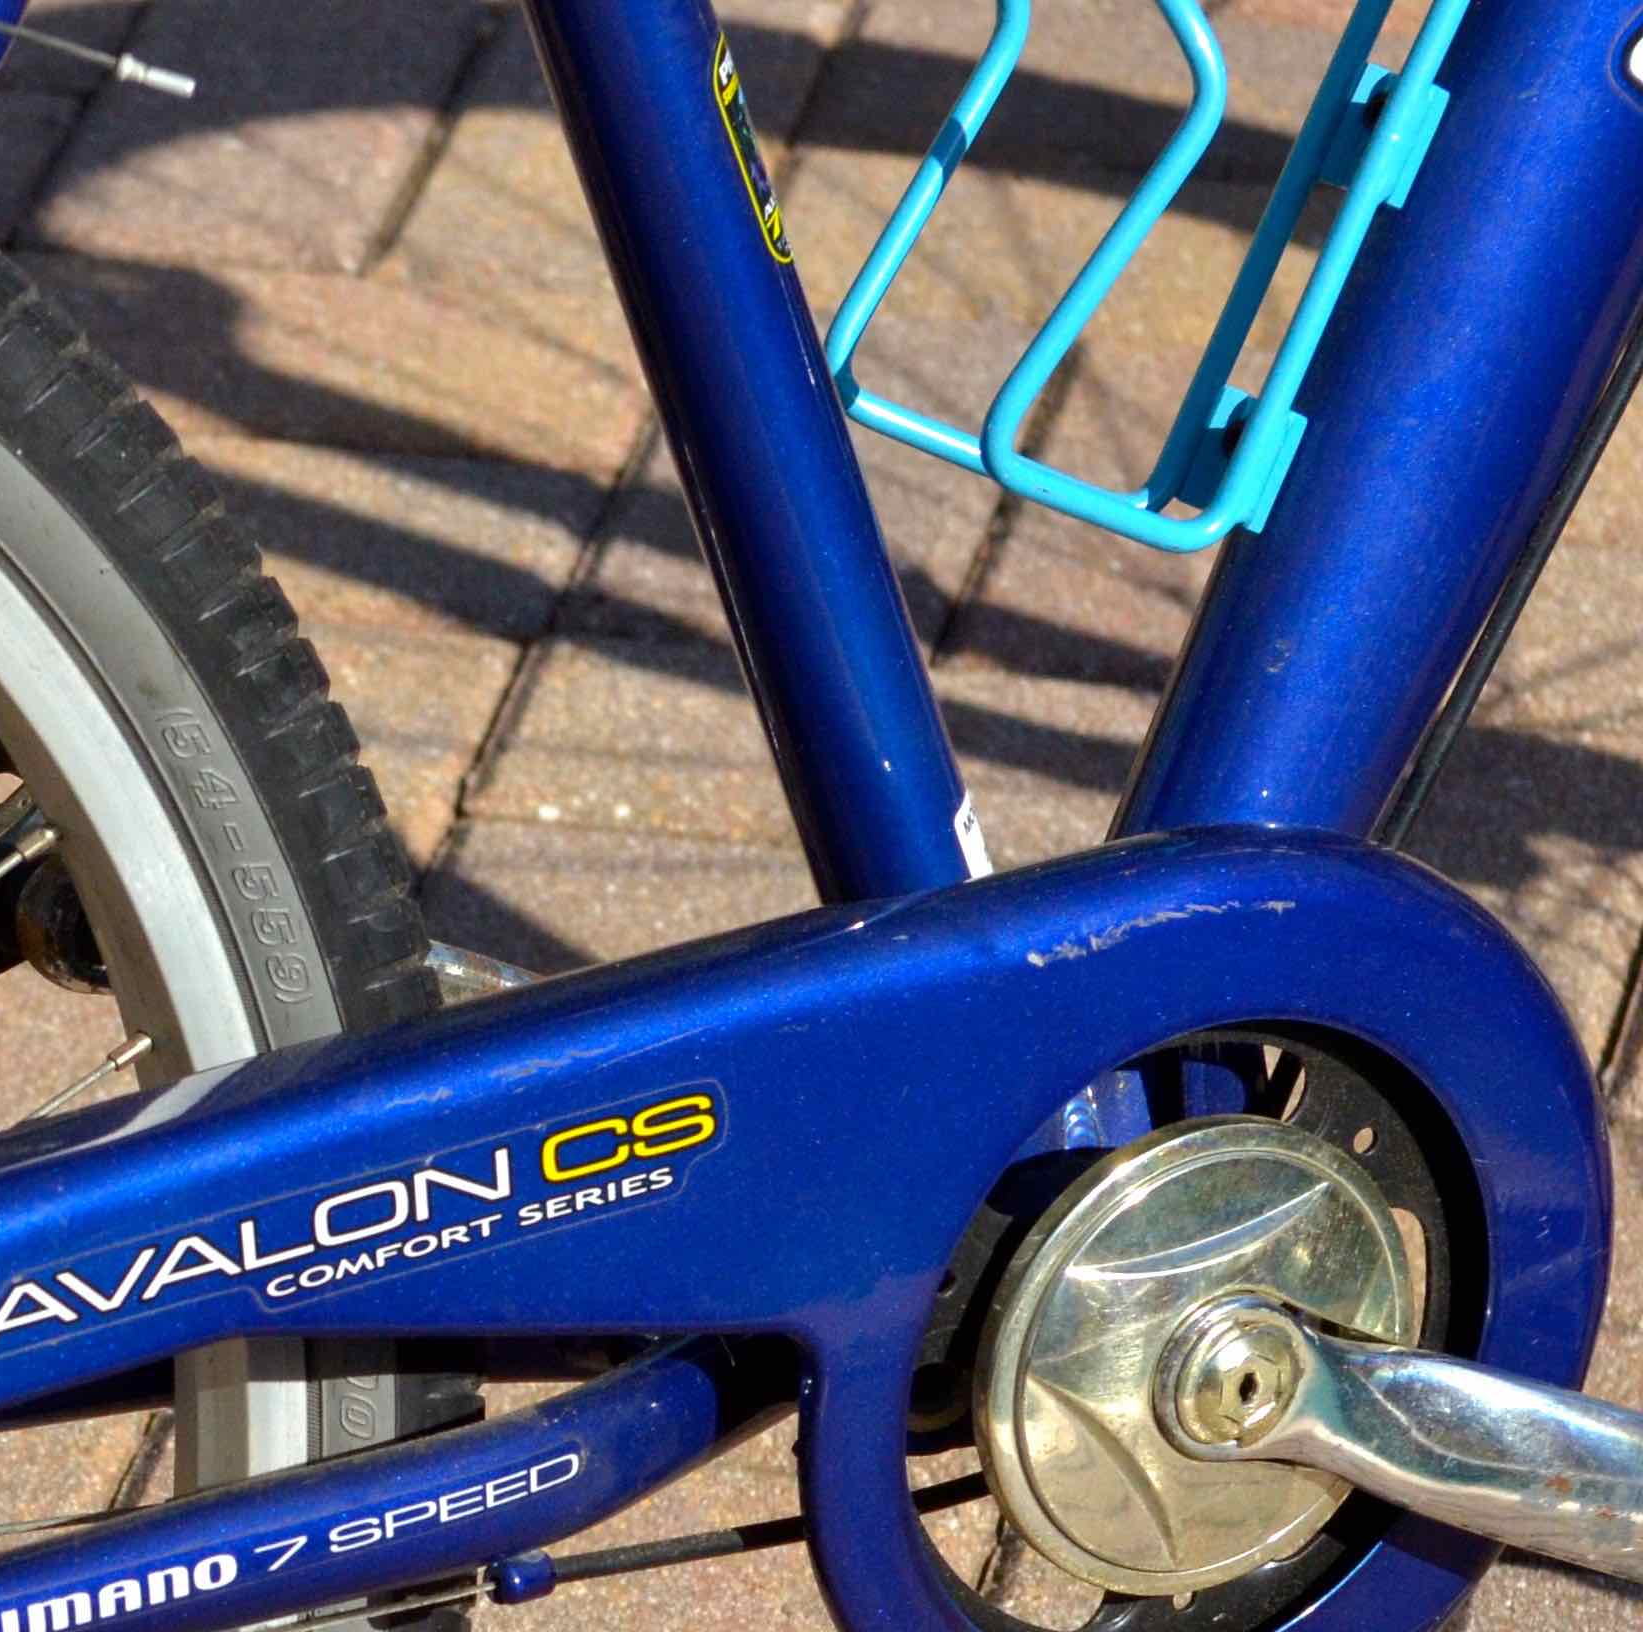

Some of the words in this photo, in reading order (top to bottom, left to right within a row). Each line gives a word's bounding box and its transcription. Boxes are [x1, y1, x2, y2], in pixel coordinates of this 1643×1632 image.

[541, 1094, 716, 1183] CS
[265, 1213, 503, 1298] COMFORT
[517, 1166, 674, 1227] SERIES
[253, 1535, 309, 1572] 7
[327, 1452, 581, 1554] SPEED
